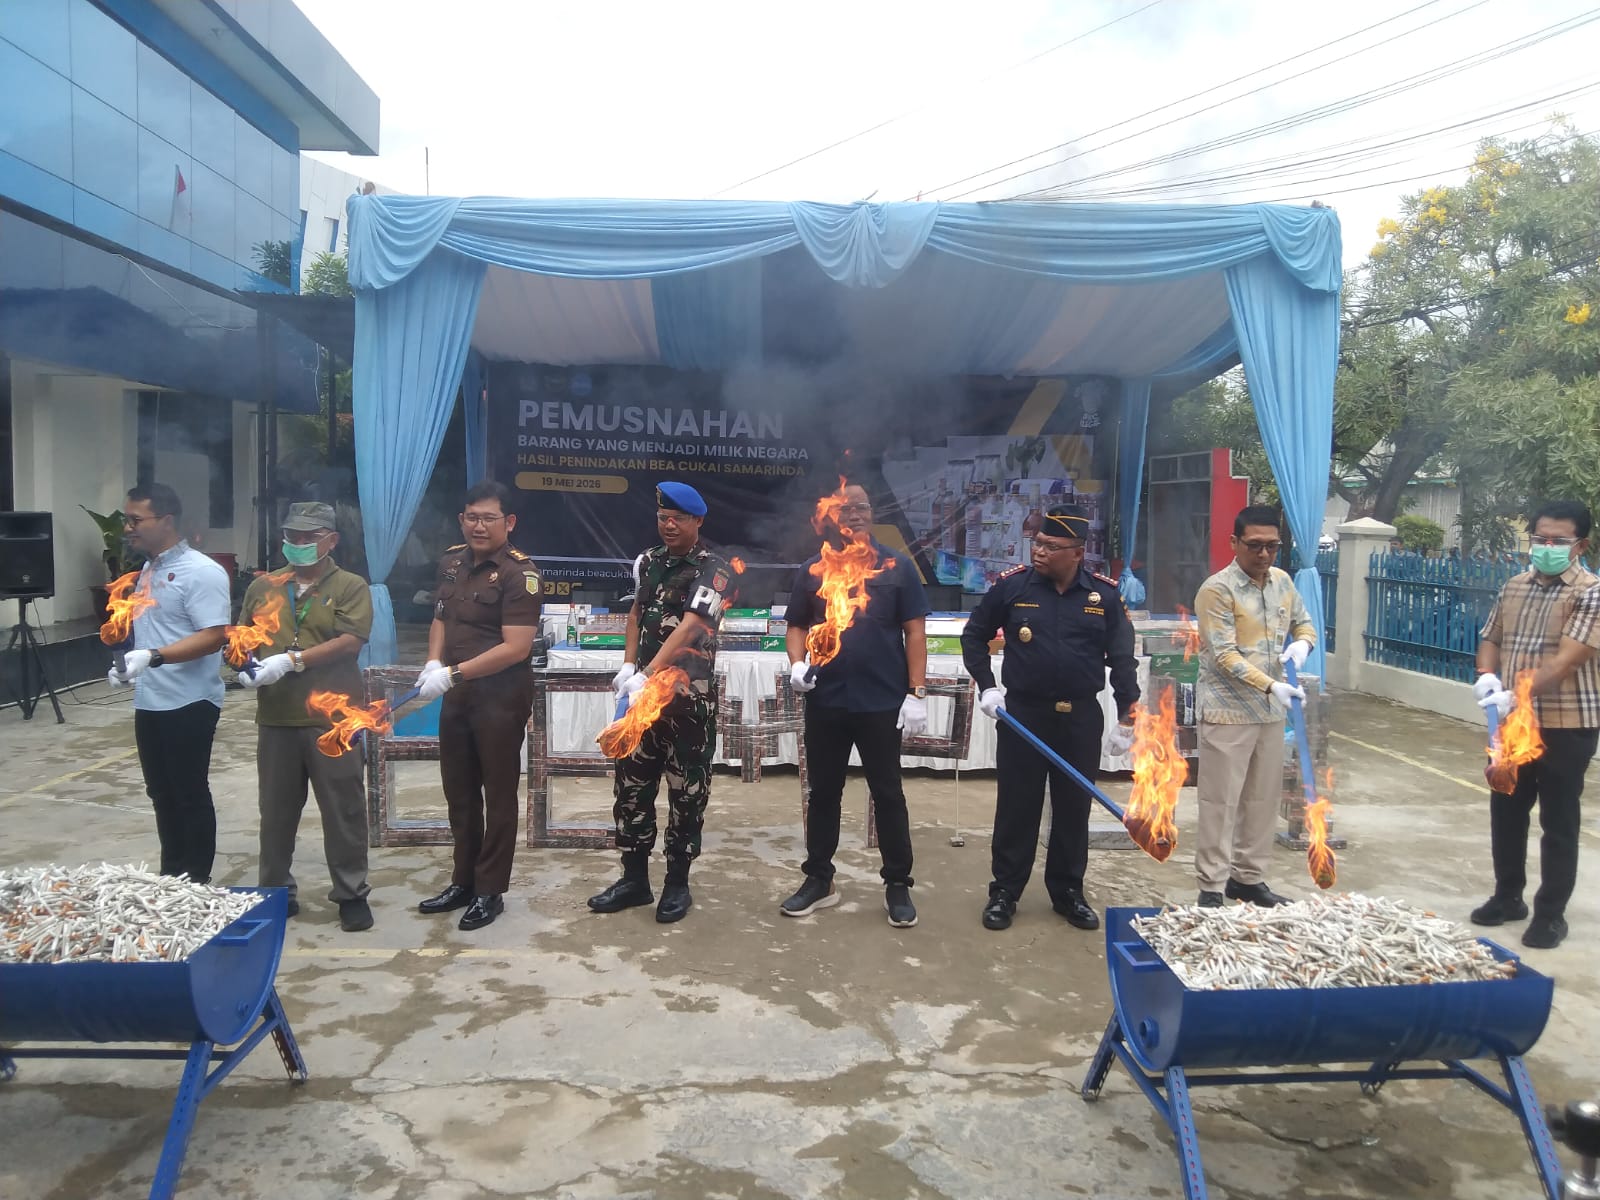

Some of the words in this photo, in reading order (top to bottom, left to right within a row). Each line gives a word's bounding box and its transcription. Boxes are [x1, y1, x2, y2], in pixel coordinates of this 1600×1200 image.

[518, 400, 783, 439] PEMUSNAHAN
[517, 434, 582, 450] BARANG
[585, 438, 629, 452] YANG
[632, 440, 700, 456] MENJADI
[704, 444, 743, 458] MILIK
[747, 446, 809, 460] NEGARA
[517, 453, 556, 466] HASIL
[559, 455, 646, 470] PENINDAKAN
[649, 459, 675, 471] BEA
[679, 460, 720, 473] CUKAI
[723, 463, 806, 477] SAMARINDA
[542, 477, 553, 486] 19
[555, 478, 574, 488] MEI
